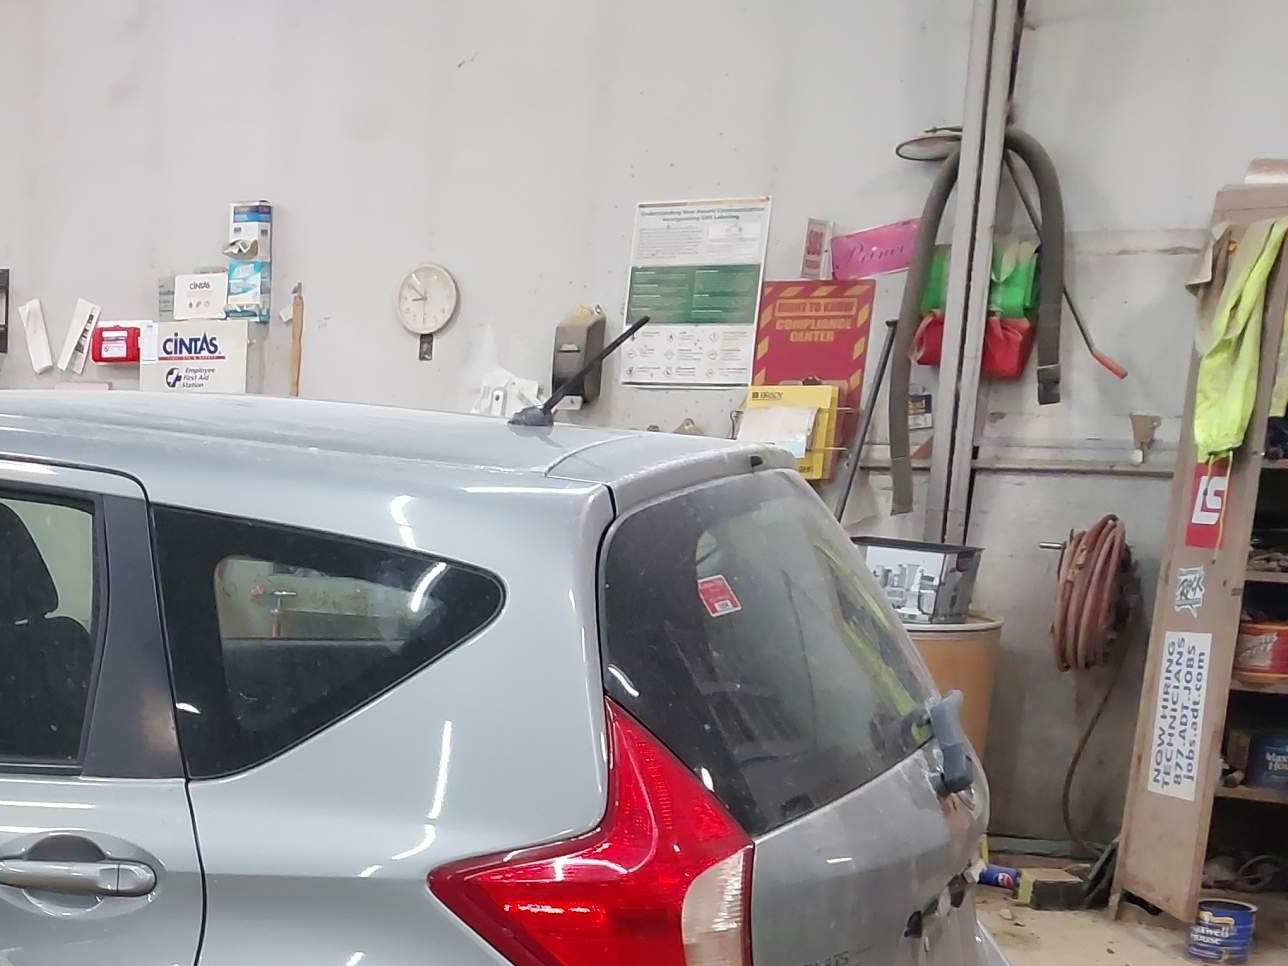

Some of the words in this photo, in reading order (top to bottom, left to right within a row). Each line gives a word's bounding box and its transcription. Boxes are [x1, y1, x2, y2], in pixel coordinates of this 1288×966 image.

[162, 332, 219, 355] CINTAS
[1153, 727, 1166, 784] NOW
[1160, 640, 1176, 720] HIRING
[1161, 636, 1185, 789] TECHNICIANS
